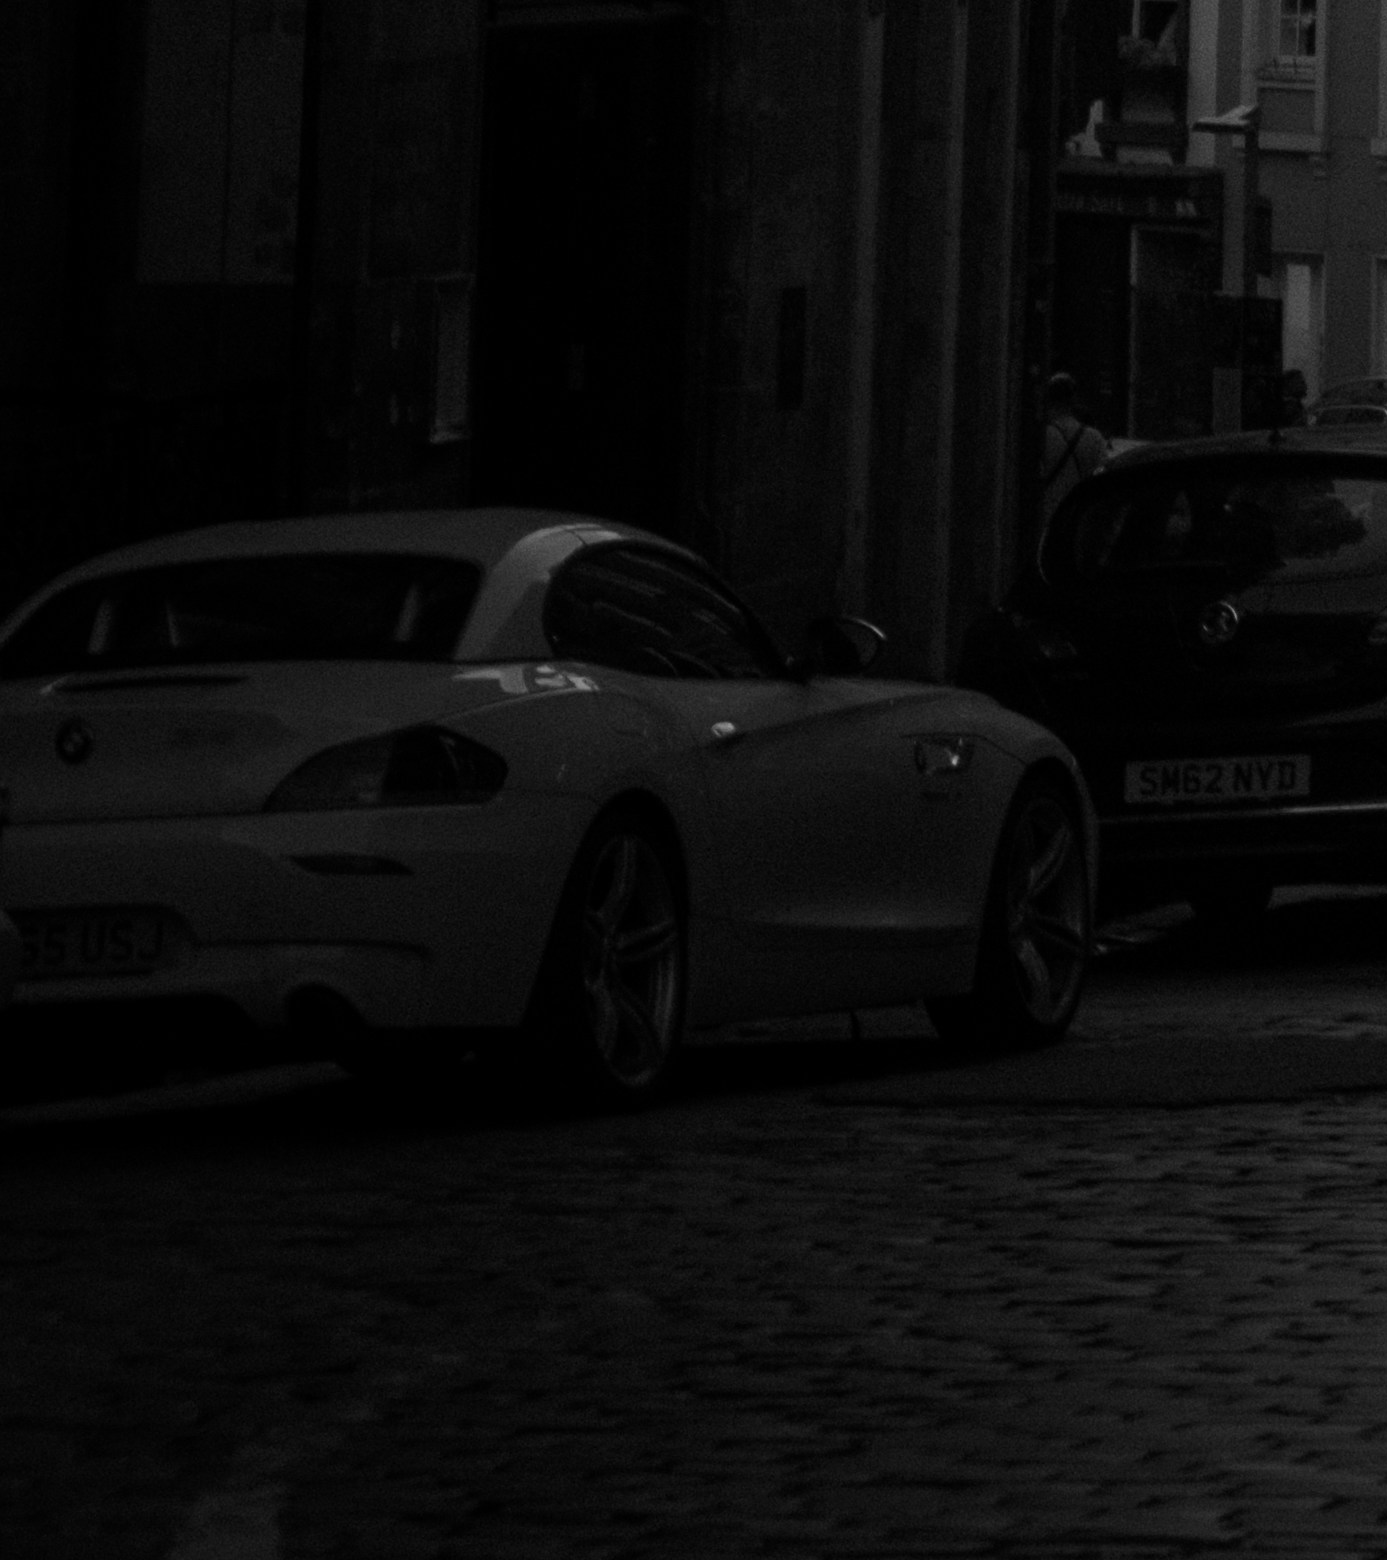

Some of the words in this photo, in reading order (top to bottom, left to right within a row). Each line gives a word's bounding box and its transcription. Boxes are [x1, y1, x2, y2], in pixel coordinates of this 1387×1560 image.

[1140, 764, 1223, 796] SM62
[1234, 761, 1297, 793] NYD
[81, 921, 164, 963] USJ
